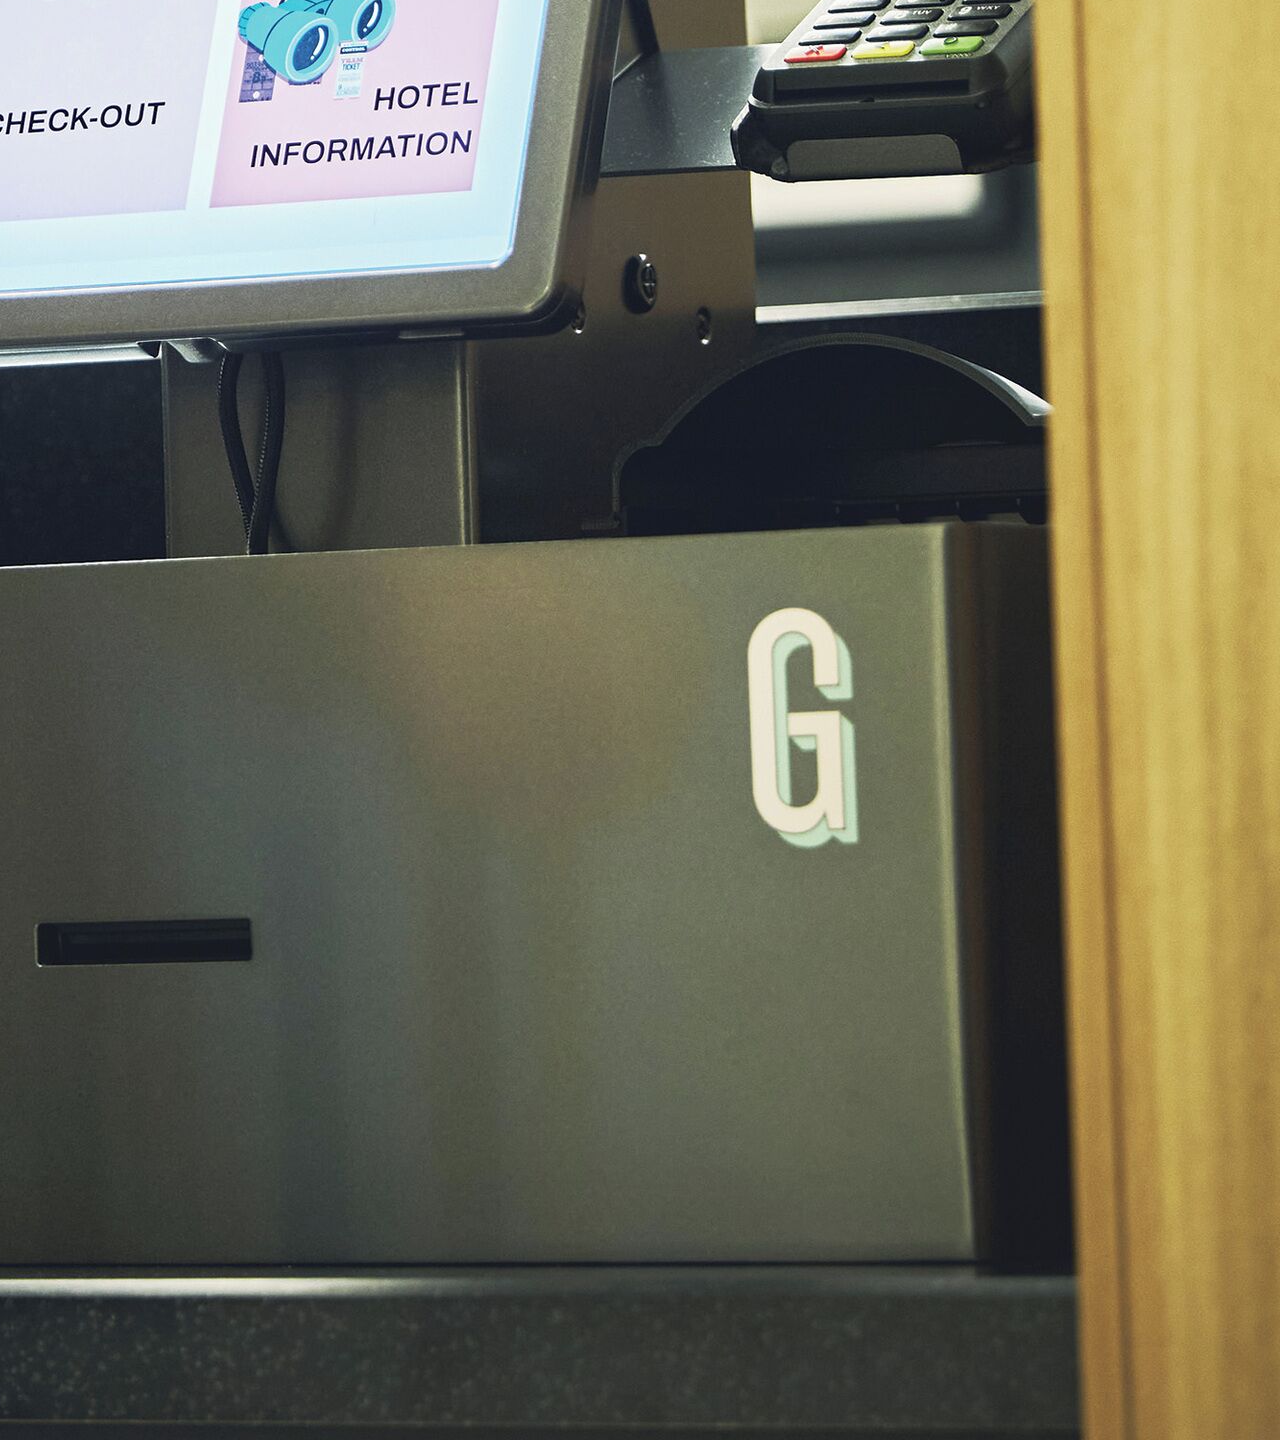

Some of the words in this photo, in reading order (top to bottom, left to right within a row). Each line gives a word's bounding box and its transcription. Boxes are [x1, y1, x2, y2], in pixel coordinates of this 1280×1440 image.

[958, 6, 973, 15] 9
[373, 81, 479, 111] HOTEL
[250, 129, 473, 168] INFORMATION
[747, 606, 859, 849] G
